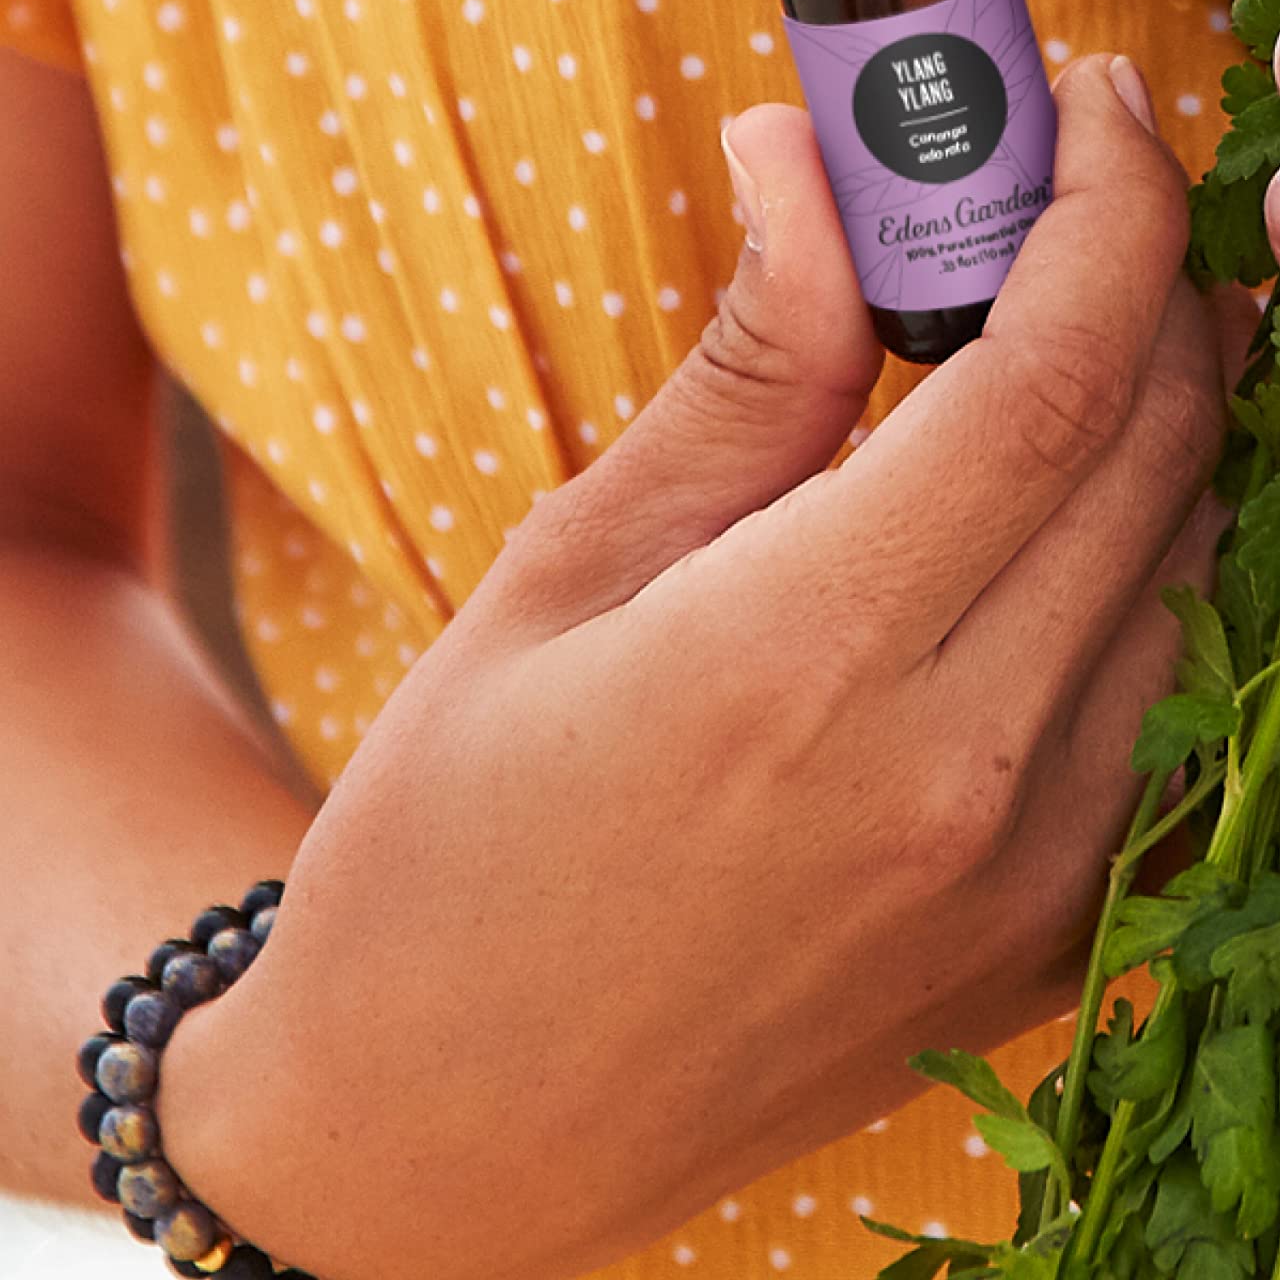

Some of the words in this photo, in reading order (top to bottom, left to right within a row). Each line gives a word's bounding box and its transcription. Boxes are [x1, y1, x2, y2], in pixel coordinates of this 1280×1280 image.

[891, 51, 947, 83] YLANG
[898, 78, 955, 111] YLANG
[877, 213, 952, 247] Edens
[955, 183, 1050, 228] Garden
